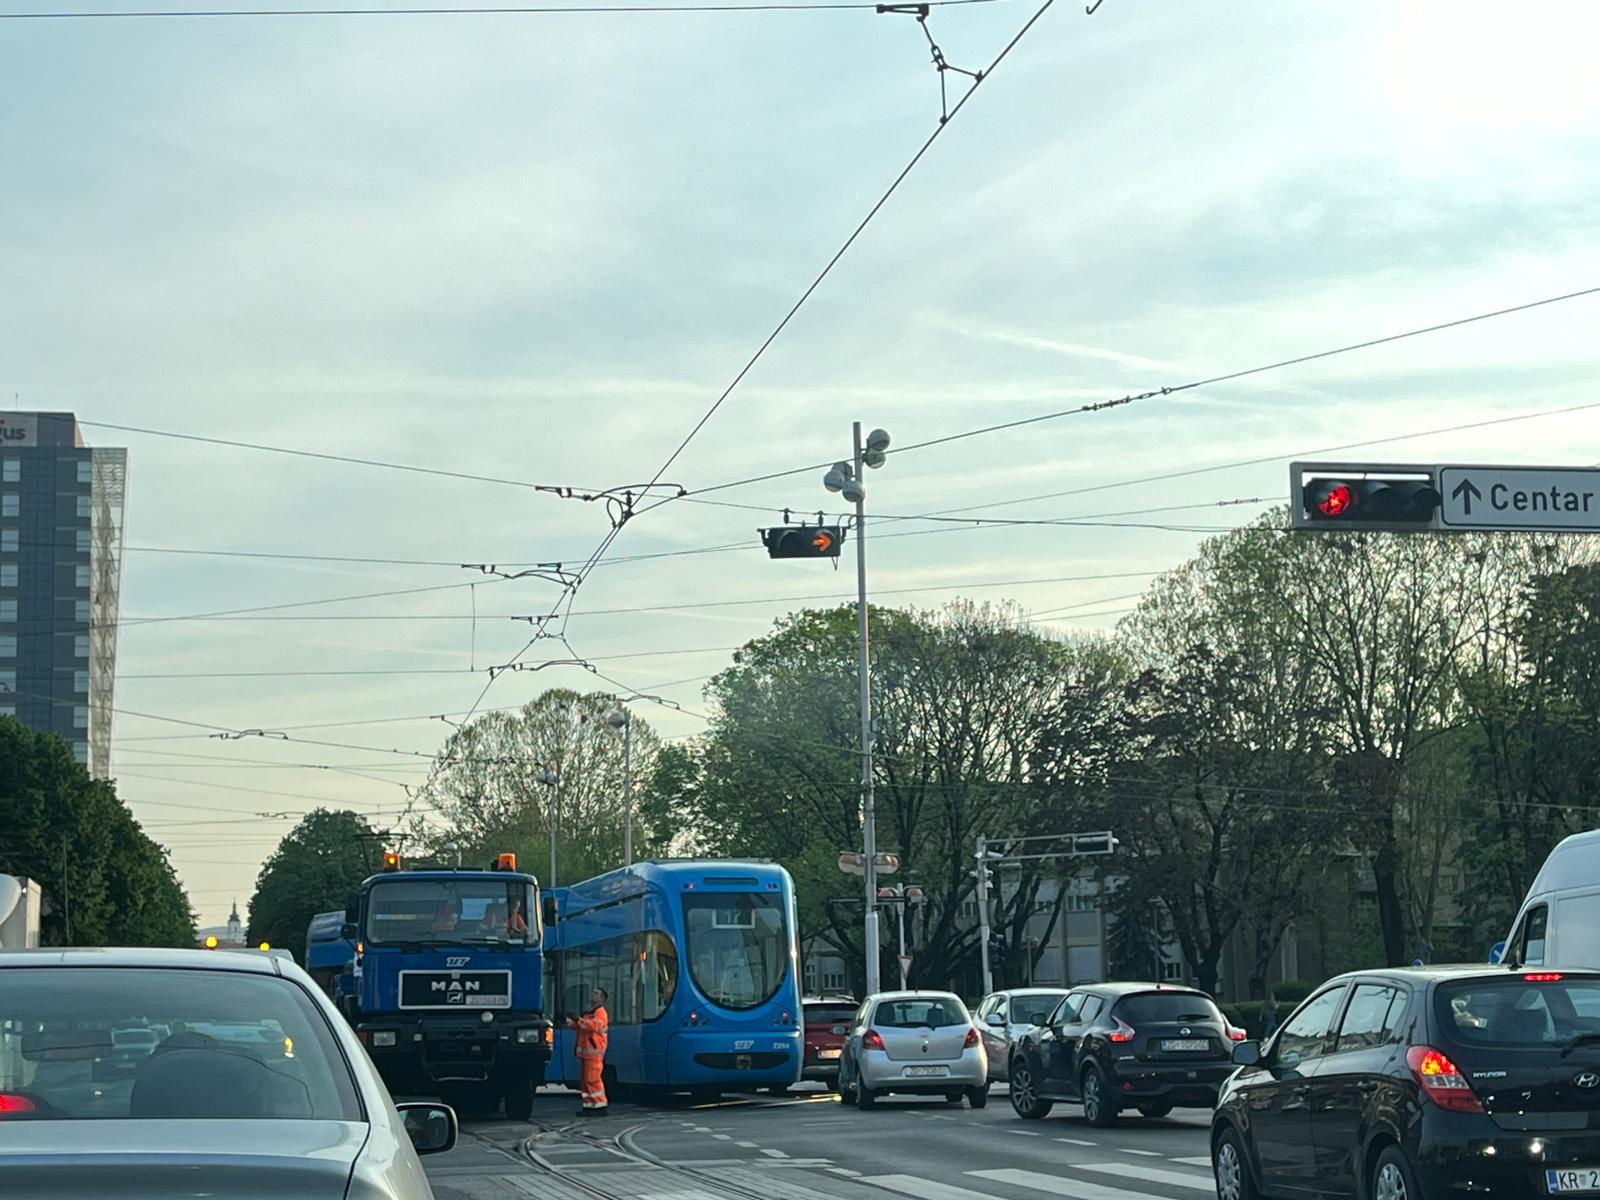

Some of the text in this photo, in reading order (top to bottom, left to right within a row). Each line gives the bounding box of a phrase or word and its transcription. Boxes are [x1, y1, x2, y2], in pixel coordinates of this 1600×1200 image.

[1490, 483, 1594, 512] Centar
[431, 981, 480, 991] MAN
[1558, 1172, 1579, 1189] KR
